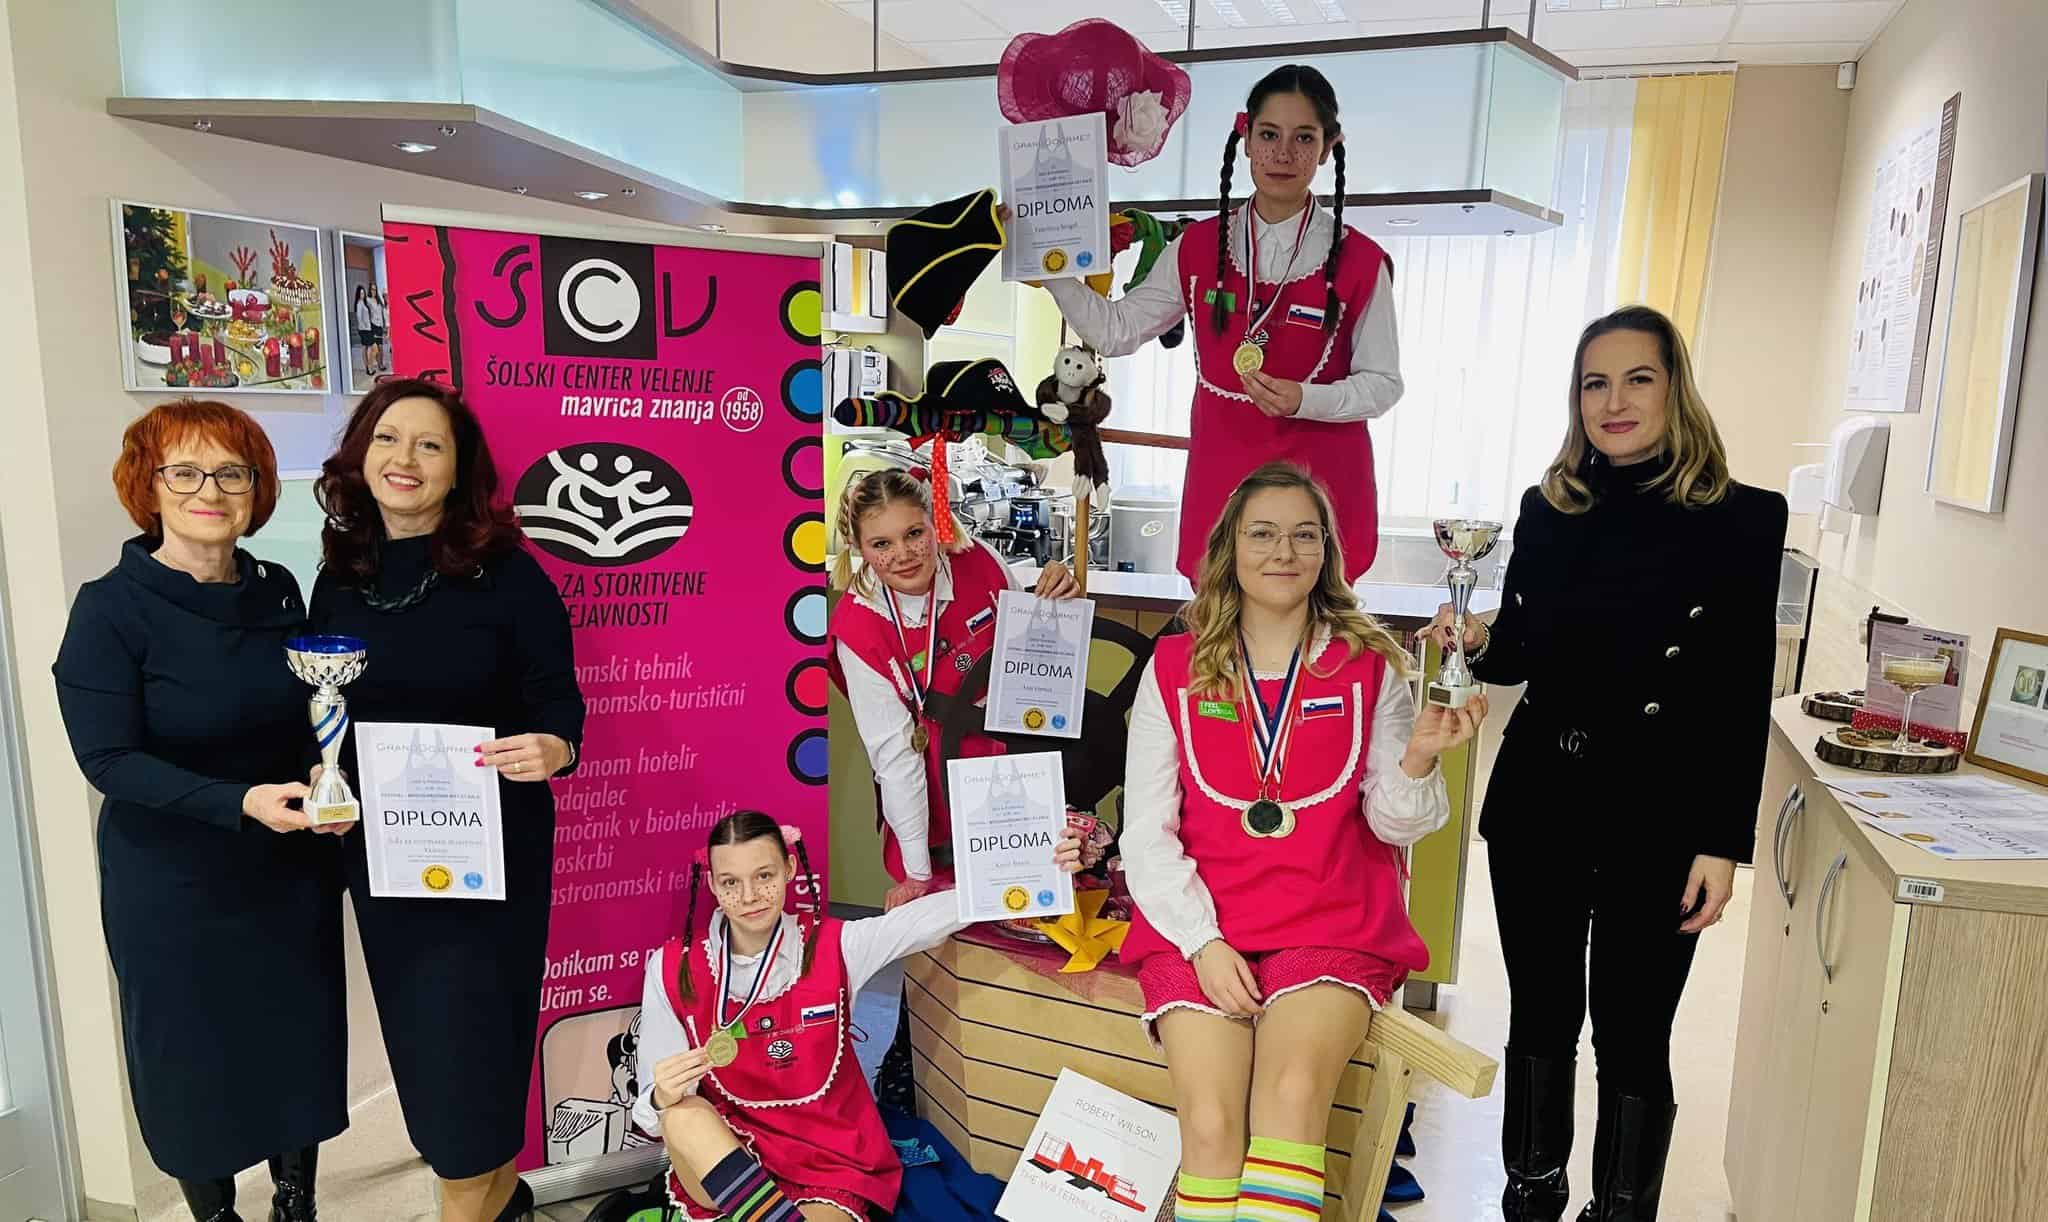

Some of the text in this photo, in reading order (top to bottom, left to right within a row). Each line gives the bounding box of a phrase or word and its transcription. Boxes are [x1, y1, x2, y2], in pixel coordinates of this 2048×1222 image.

[1017, 195, 1094, 218] DIPLOMA
[486, 356, 715, 394] ŠOLSKI CENTER VELENJE
[736, 390, 751, 402] od
[560, 396, 715, 425] mavrica znanja
[725, 401, 760, 422] 1958
[561, 571, 709, 598] ZA STORITVENE
[566, 602, 669, 628] EJAVNOSTI
[634, 652, 694, 682] tehnik
[1005, 660, 1073, 679] DIPLOMA
[584, 682, 747, 716] nomsko-turistični
[576, 744, 698, 779] onom hotelir
[555, 780, 628, 815] dajalec
[384, 810, 483, 827] DIPLOMA
[554, 811, 621, 844] močnik
[629, 817, 640, 835] v
[970, 831, 1052, 853] DIPLOMA
[620, 950, 639, 969] se
[588, 984, 613, 1004] se.
[1074, 1098, 1114, 1121] ROBERT
[1118, 1119, 1158, 1143] WILSON
